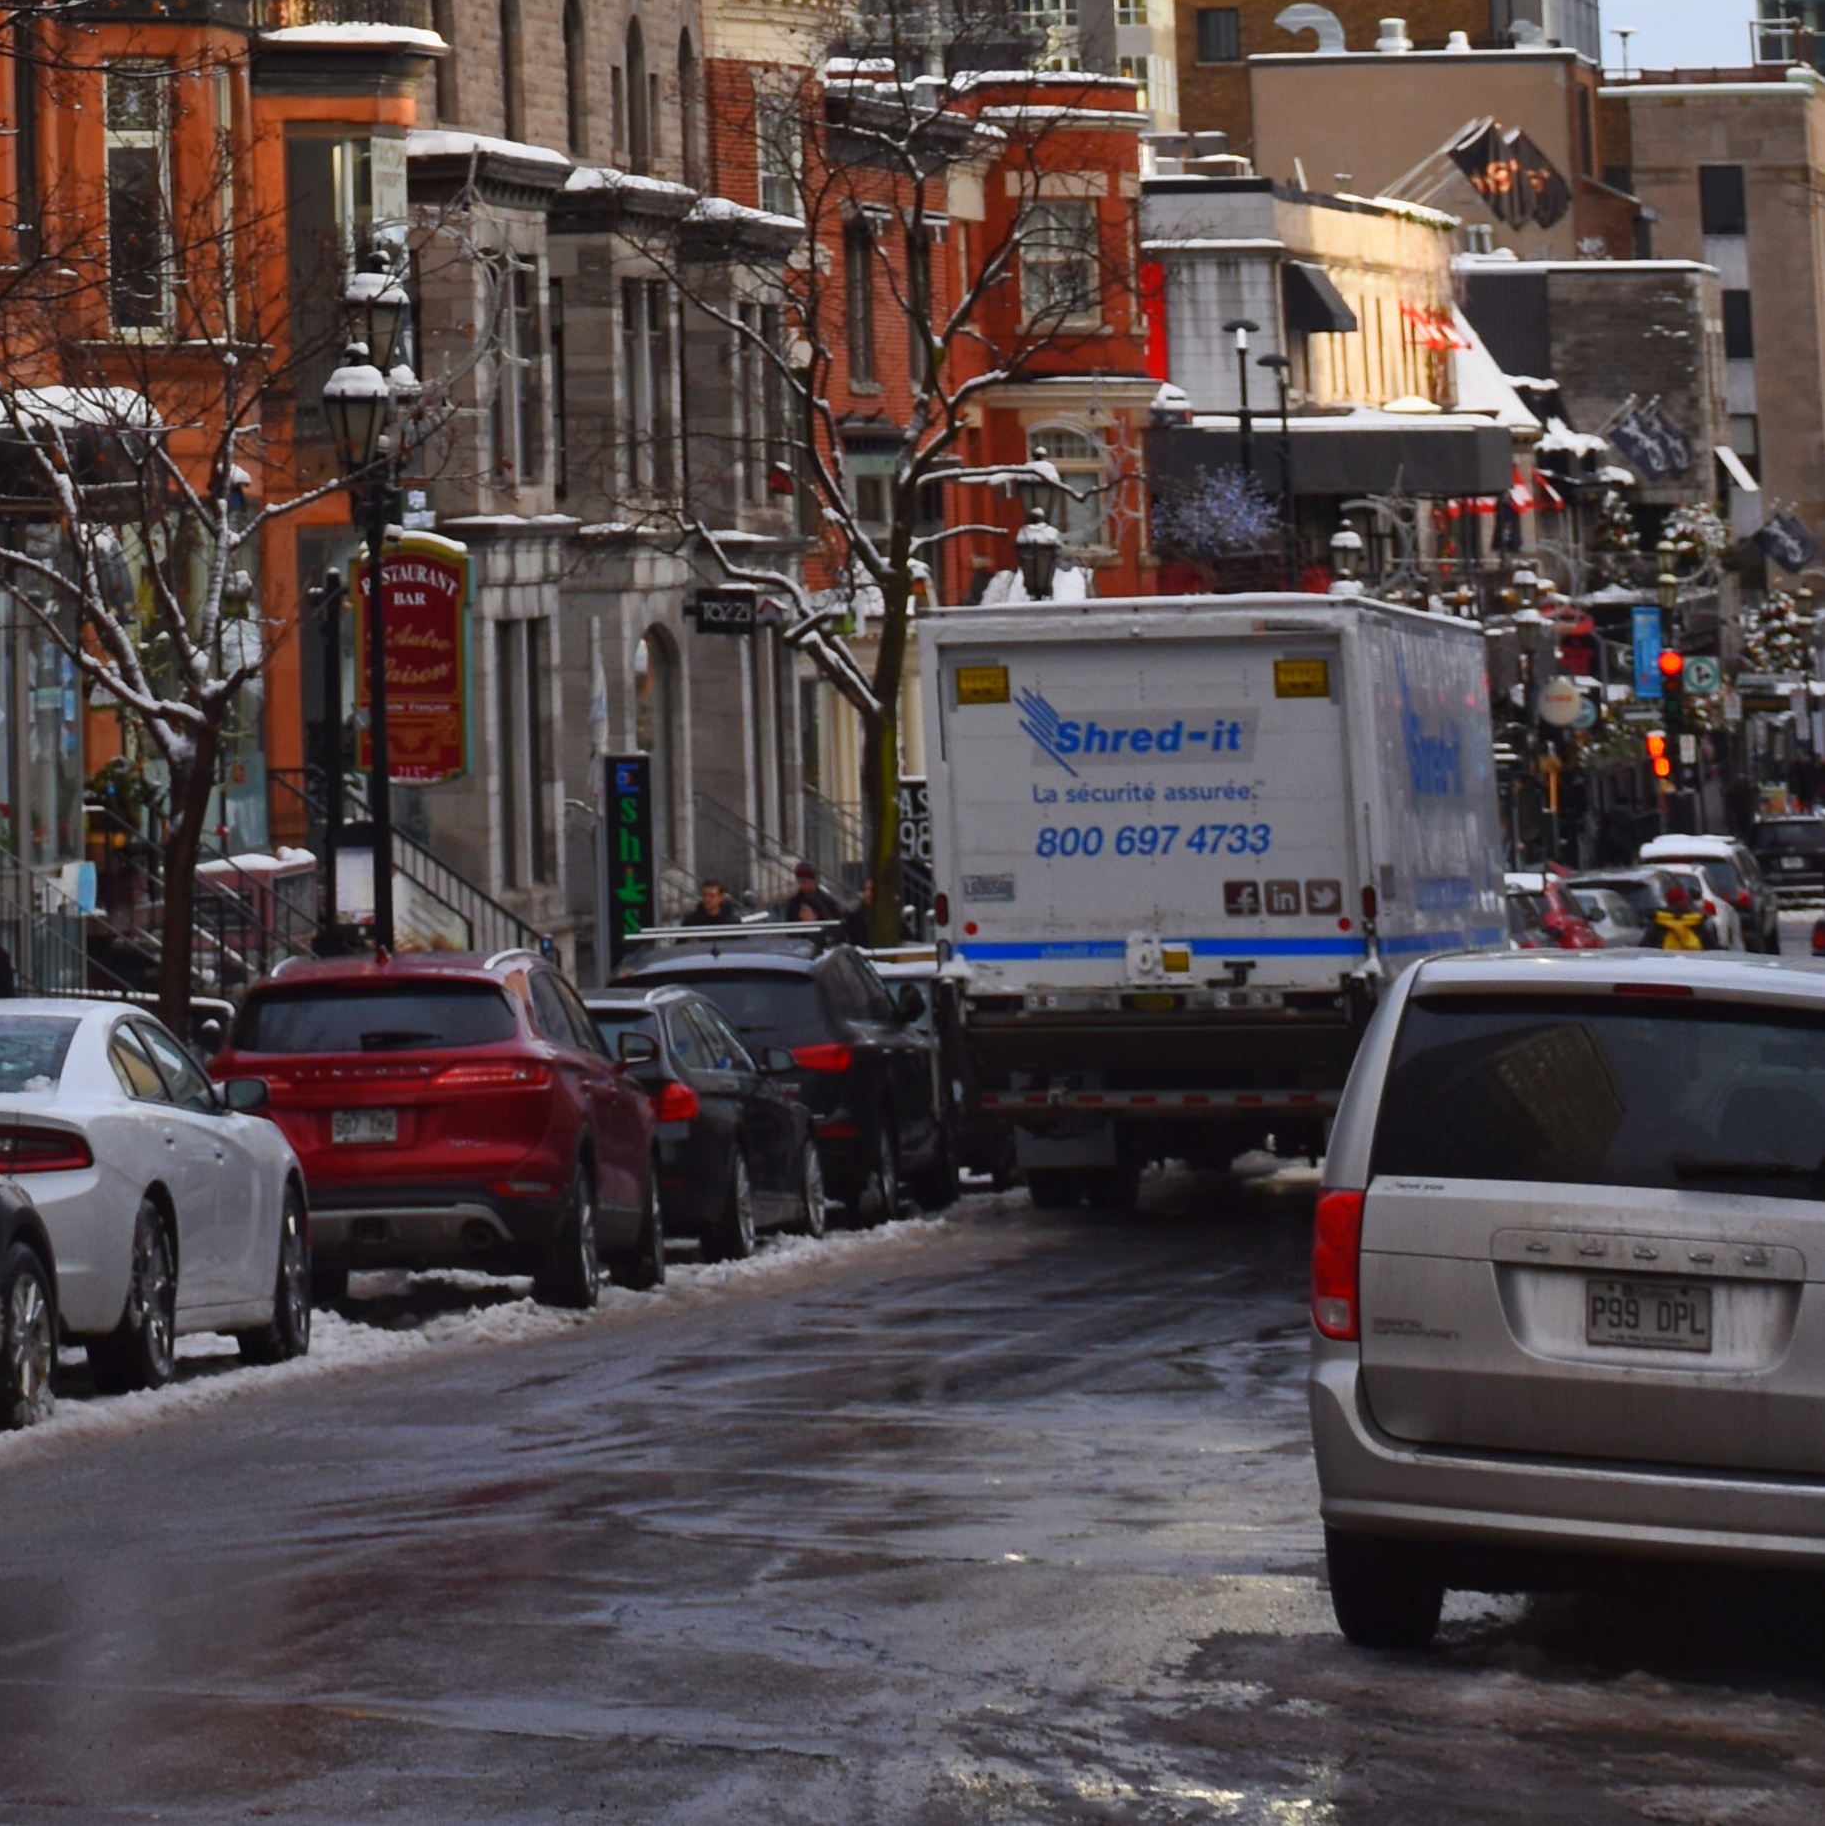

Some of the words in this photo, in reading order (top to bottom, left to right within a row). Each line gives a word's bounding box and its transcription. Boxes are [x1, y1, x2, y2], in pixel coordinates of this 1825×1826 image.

[361, 564, 459, 597] RSTAURANT
[394, 592, 426, 605] BAR
[1054, 719, 1241, 754] Shred-it
[1032, 784, 1057, 803] La
[1066, 783, 1155, 802] sécurité
[1036, 826, 1104, 857] 800
[1115, 825, 1179, 856] 697
[1187, 824, 1271, 855] 4733
[1591, 1295, 1639, 1329] P99
[1656, 1300, 1705, 1335] DPL
